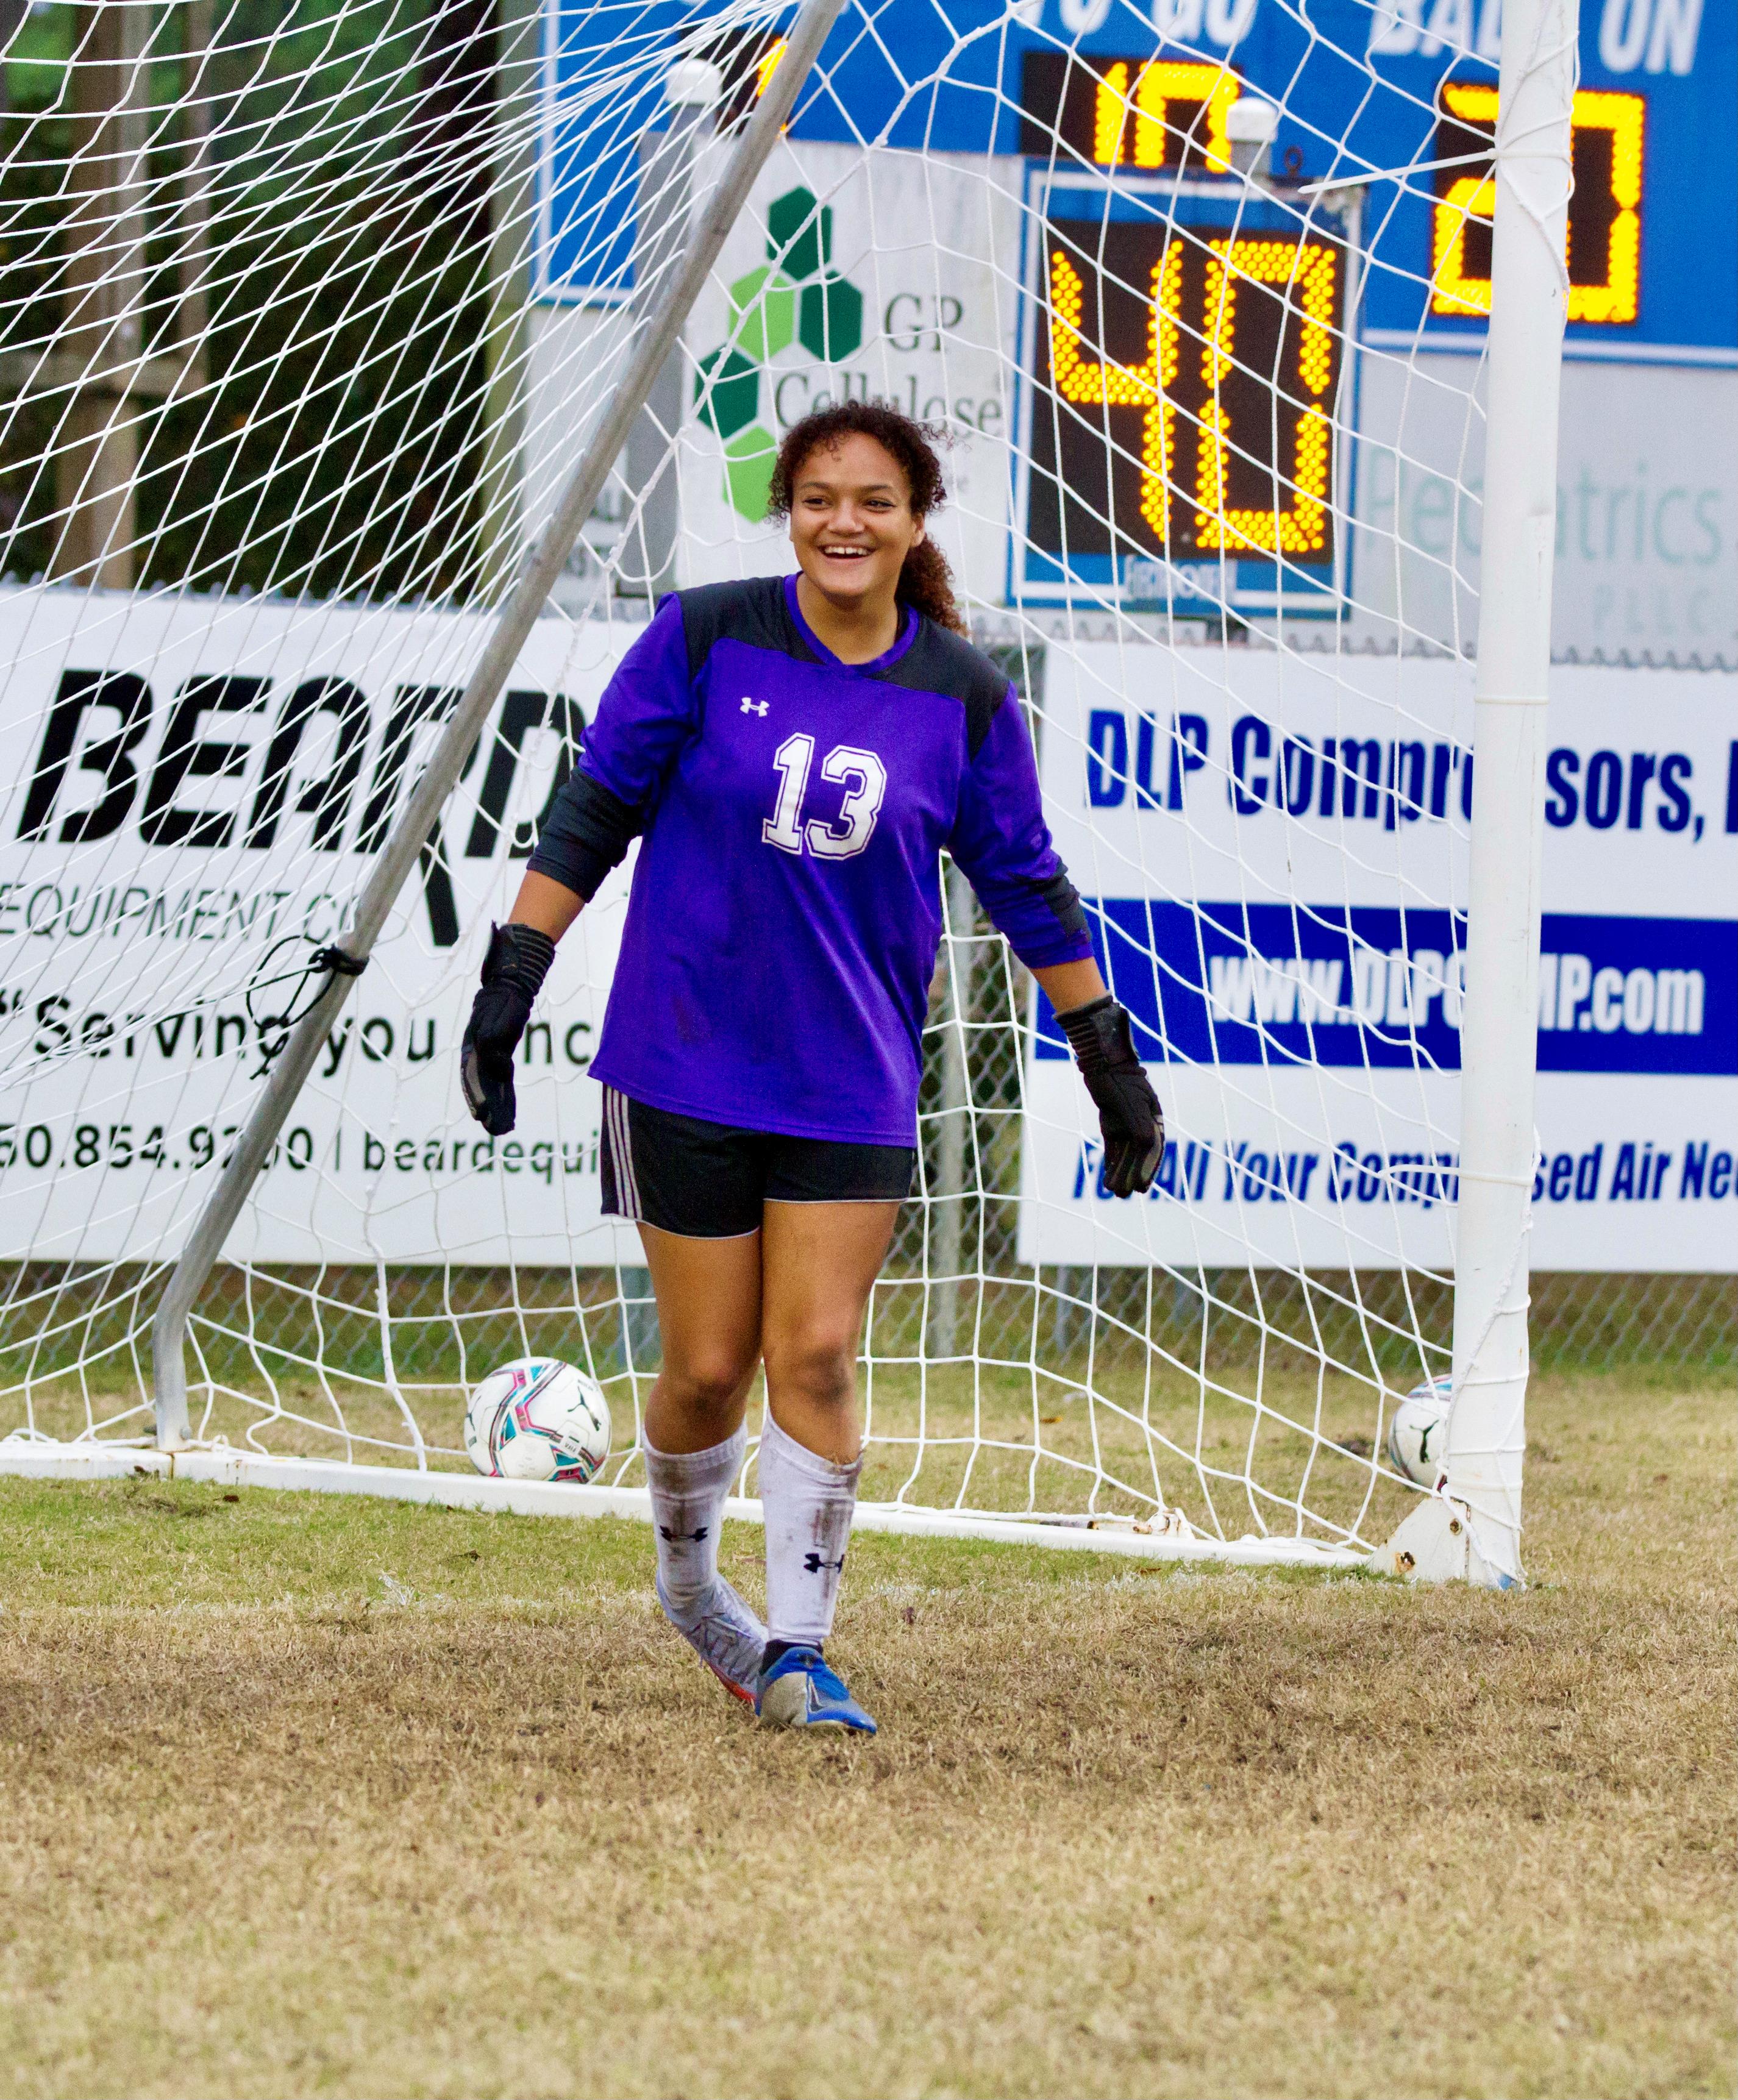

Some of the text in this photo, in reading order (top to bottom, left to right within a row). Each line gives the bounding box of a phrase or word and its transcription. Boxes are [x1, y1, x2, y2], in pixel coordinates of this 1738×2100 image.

[884, 293, 964, 352] GP
[1050, 240, 1336, 552] 40
[1364, 448, 1723, 566] Petrics
[16, 669, 586, 947] BEARD
[761, 732, 887, 861] 13
[1088, 709, 1209, 811] DLP
[1230, 714, 1705, 844] Comprsors,
[0, 884, 291, 940] EQUIPMENT
[1209, 948, 1706, 1035] www.DLPCP.com
[322, 1016, 436, 1079] you
[0, 1123, 313, 1172] 50.854.90
[1149, 1139, 1212, 1202] All
[1223, 1138, 1320, 1203] Your
[1327, 1140, 1604, 1209] Compsed
[1608, 1141, 1672, 1201] Air
